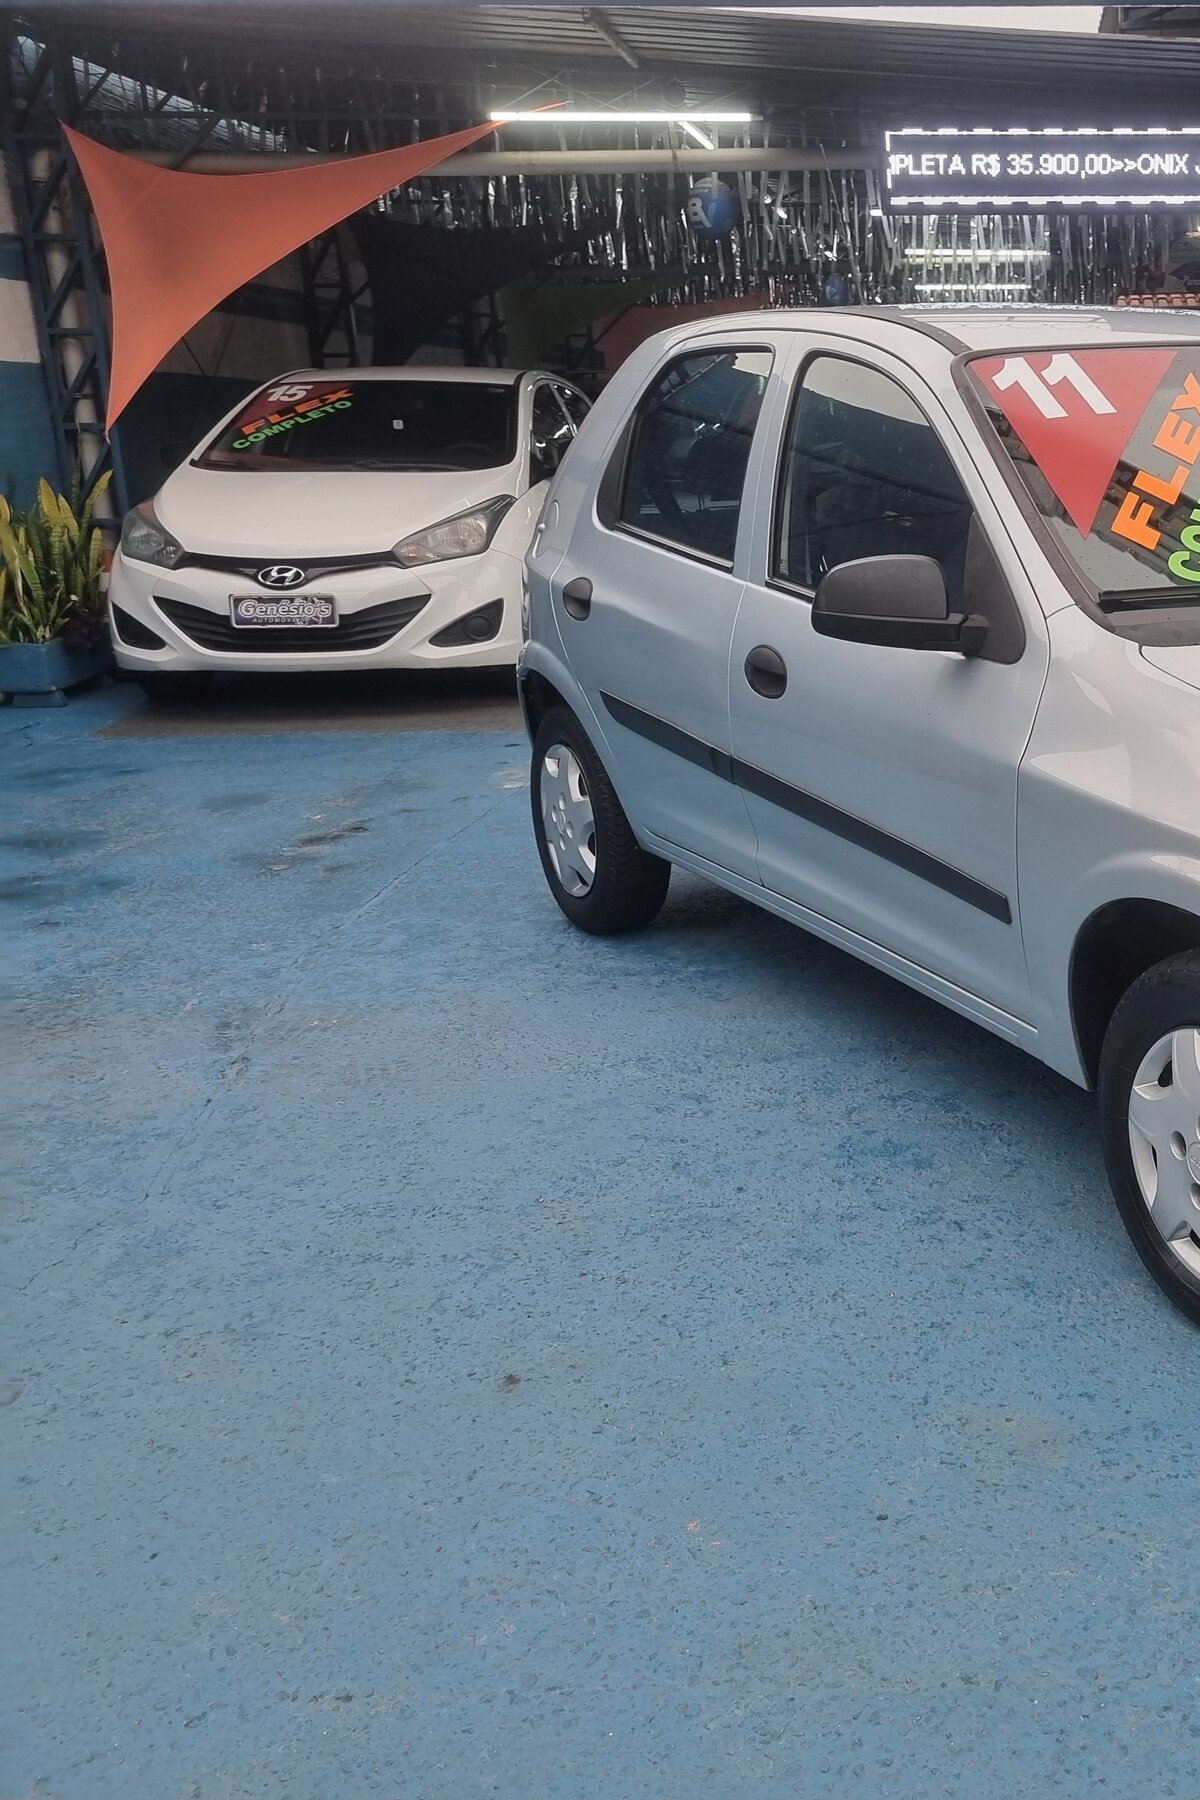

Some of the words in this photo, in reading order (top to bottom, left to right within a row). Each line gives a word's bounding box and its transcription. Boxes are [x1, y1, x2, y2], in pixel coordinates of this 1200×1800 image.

[971, 154, 1000, 177] R$
[267, 385, 314, 402] 15
[991, 353, 1118, 419] 11
[232, 400, 352, 449] COMPLETO
[241, 388, 354, 435] FLEX
[239, 599, 332, 618] Genésio's
